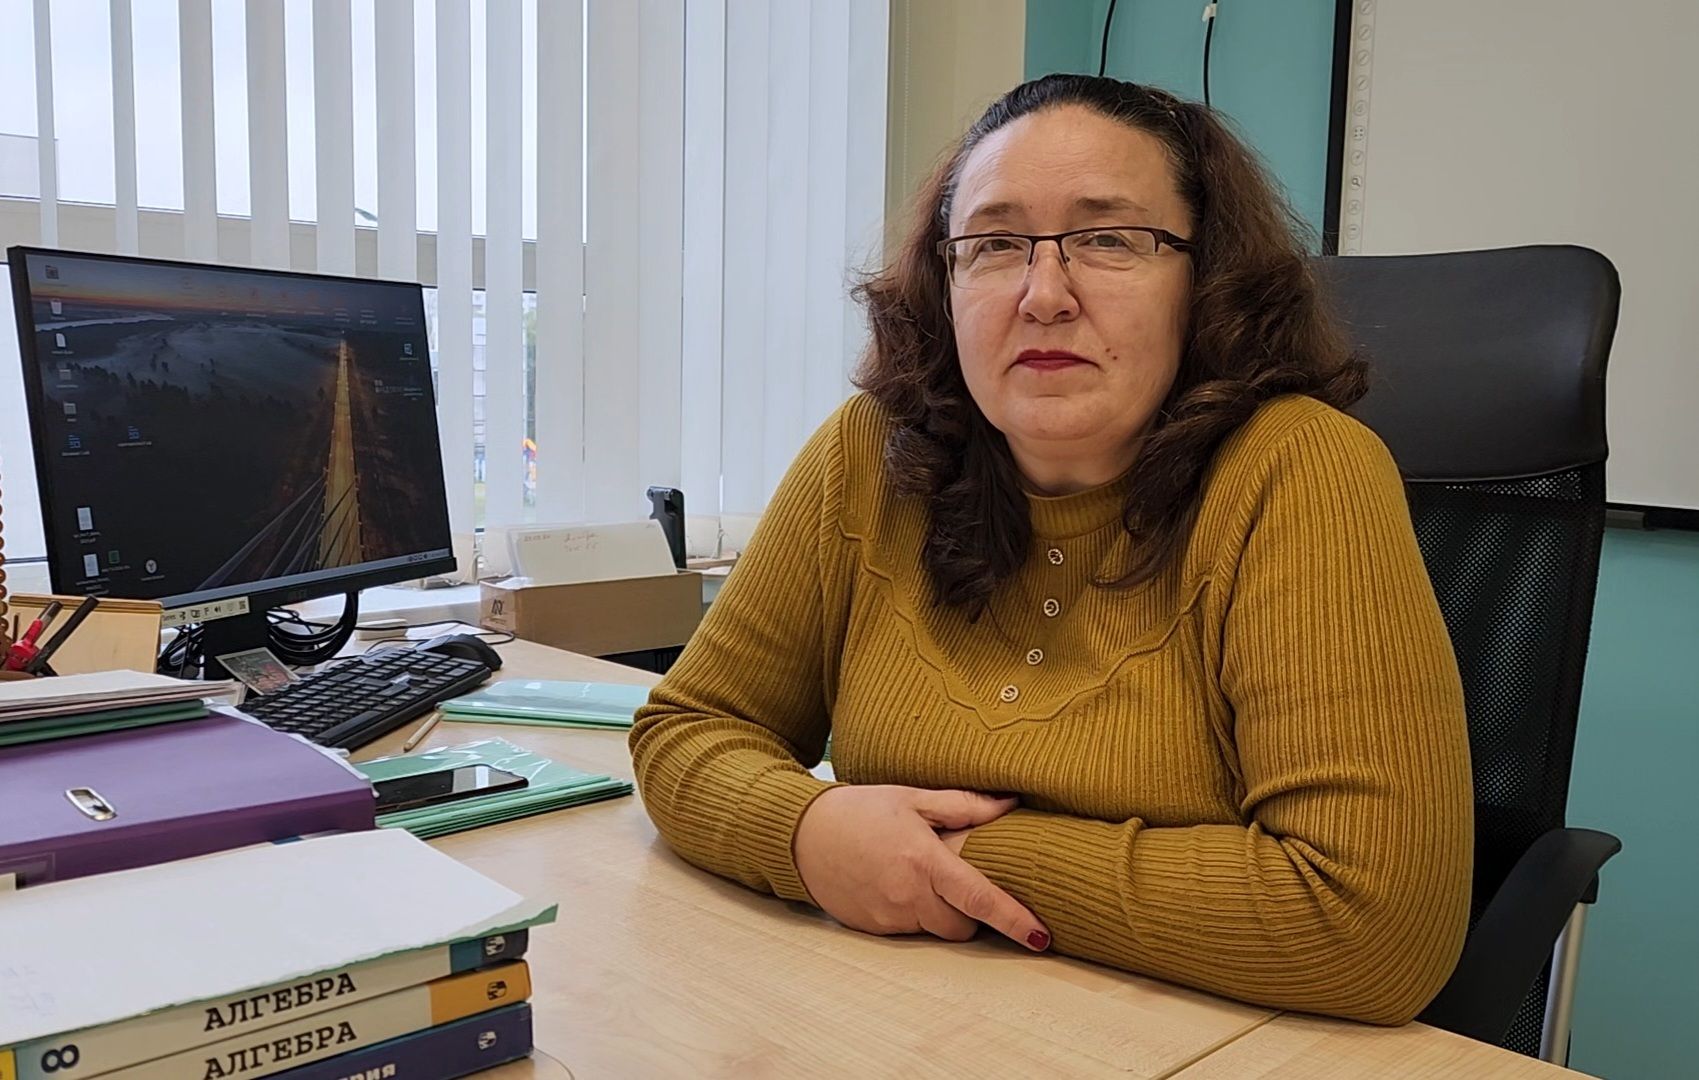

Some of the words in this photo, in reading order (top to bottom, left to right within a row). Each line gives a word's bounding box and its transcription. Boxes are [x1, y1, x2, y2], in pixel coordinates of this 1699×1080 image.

[204, 973, 357, 1032] АЛГЕБРА
[41, 1044, 80, 1074] 8
[203, 1021, 357, 1080] АЛГЕБРА
[338, 1063, 396, 1080] рия
